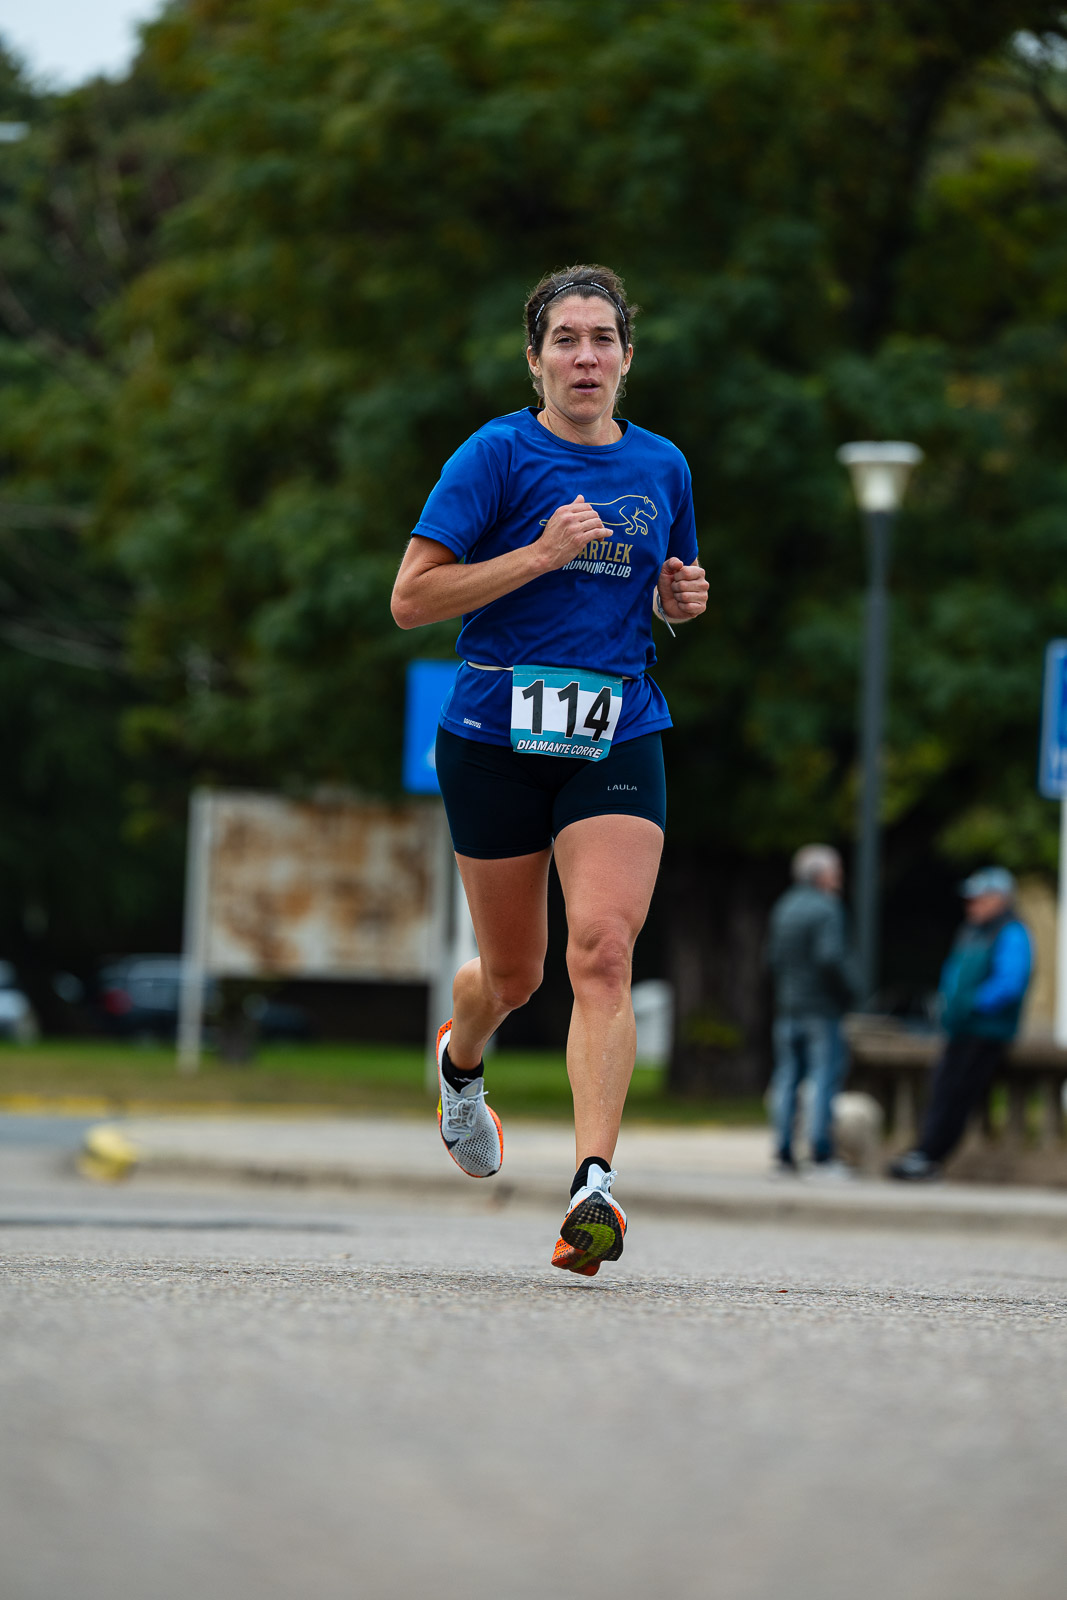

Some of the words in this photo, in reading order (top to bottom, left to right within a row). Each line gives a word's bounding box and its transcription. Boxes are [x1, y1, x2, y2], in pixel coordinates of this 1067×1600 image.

[578, 540, 634, 564] ARTLEK
[521, 679, 612, 742] 114
[516, 739, 572, 754] DIAMANTE
[570, 745, 604, 759] CORRE
[607, 784, 638, 792] LAULA
